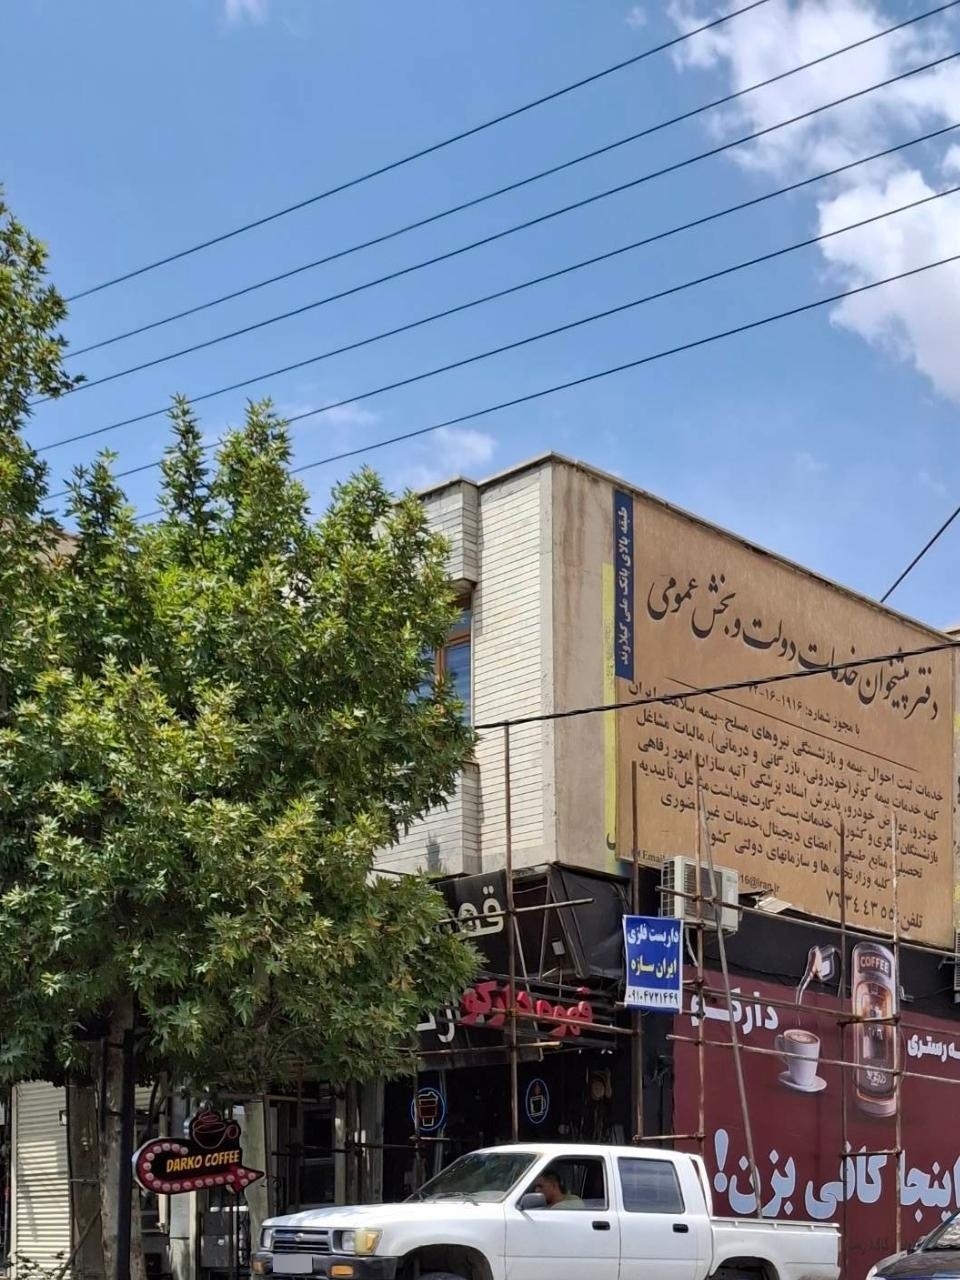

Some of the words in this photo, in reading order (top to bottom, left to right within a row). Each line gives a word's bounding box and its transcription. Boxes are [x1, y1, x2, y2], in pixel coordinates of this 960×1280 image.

[618, 506, 631, 534] طبقه
[619, 538, 631, 566] بالای
[619, 568, 629, 595] بانک
[647, 577, 698, 620] عمومی
[691, 573, 736, 638] بخش
[619, 598, 631, 622] ملی
[729, 617, 742, 638] و
[742, 618, 797, 661] دولت
[797, 645, 858, 686] خدمات
[858, 645, 910, 710] پیشخوان
[628, 682, 657, 699] ایران
[904, 666, 938, 720] دفتر
[636, 708, 669, 730] مشاغل
[832, 719, 853, 733] مجوز
[672, 721, 704, 741] مالیات
[751, 725, 789, 750] نیروهای
[854, 723, 861, 736] با
[637, 736, 669, 756] رفاهی
[671, 748, 692, 764] امور
[752, 749, 757, 763] و
[792, 741, 835, 767] بازنشستگی
[838, 757, 843, 770] و
[749, 773, 781, 796] پزشکی
[867, 766, 894, 785] احوال
[710, 783, 748, 807] بهداشت
[784, 782, 807, 798] اسناد
[896, 779, 912, 793] ثبت
[915, 784, 943, 801] خدمات
[661, 793, 701, 813] ضوری
[749, 794, 774, 811] کارت
[809, 791, 841, 816] پذیرش
[874, 792, 889, 808] بیمه
[892, 797, 921, 814] خدمات
[705, 804, 720, 821] غیر
[723, 810, 759, 828] خدمات
[800, 810, 832, 828] خدمات
[923, 808, 939, 822] کلیه
[877, 815, 907, 835] عواض
[709, 829, 731, 846] کشو
[734, 838, 762, 856] دولتی
[802, 834, 831, 851] امضای
[867, 833, 872, 846] و
[867, 854, 887, 869] منابع
[900, 842, 938, 864] بازنشستگان
[812, 860, 817, 873] و
[820, 859, 829, 873] ها
[873, 876, 890, 891] کلیه
[627, 923, 648, 944] فلزی
[648, 927, 679, 948] داربست
[631, 954, 655, 976] سازه
[655, 957, 677, 978] ایران
[860, 955, 890, 974] COFFEE
[536, 986, 593, 1037] قهوه
[690, 990, 779, 1035] دارکو
[166, 1155, 203, 1173] DARKO
[204, 1150, 240, 1167] COFFEE
[805, 1140, 889, 1220] کافی
